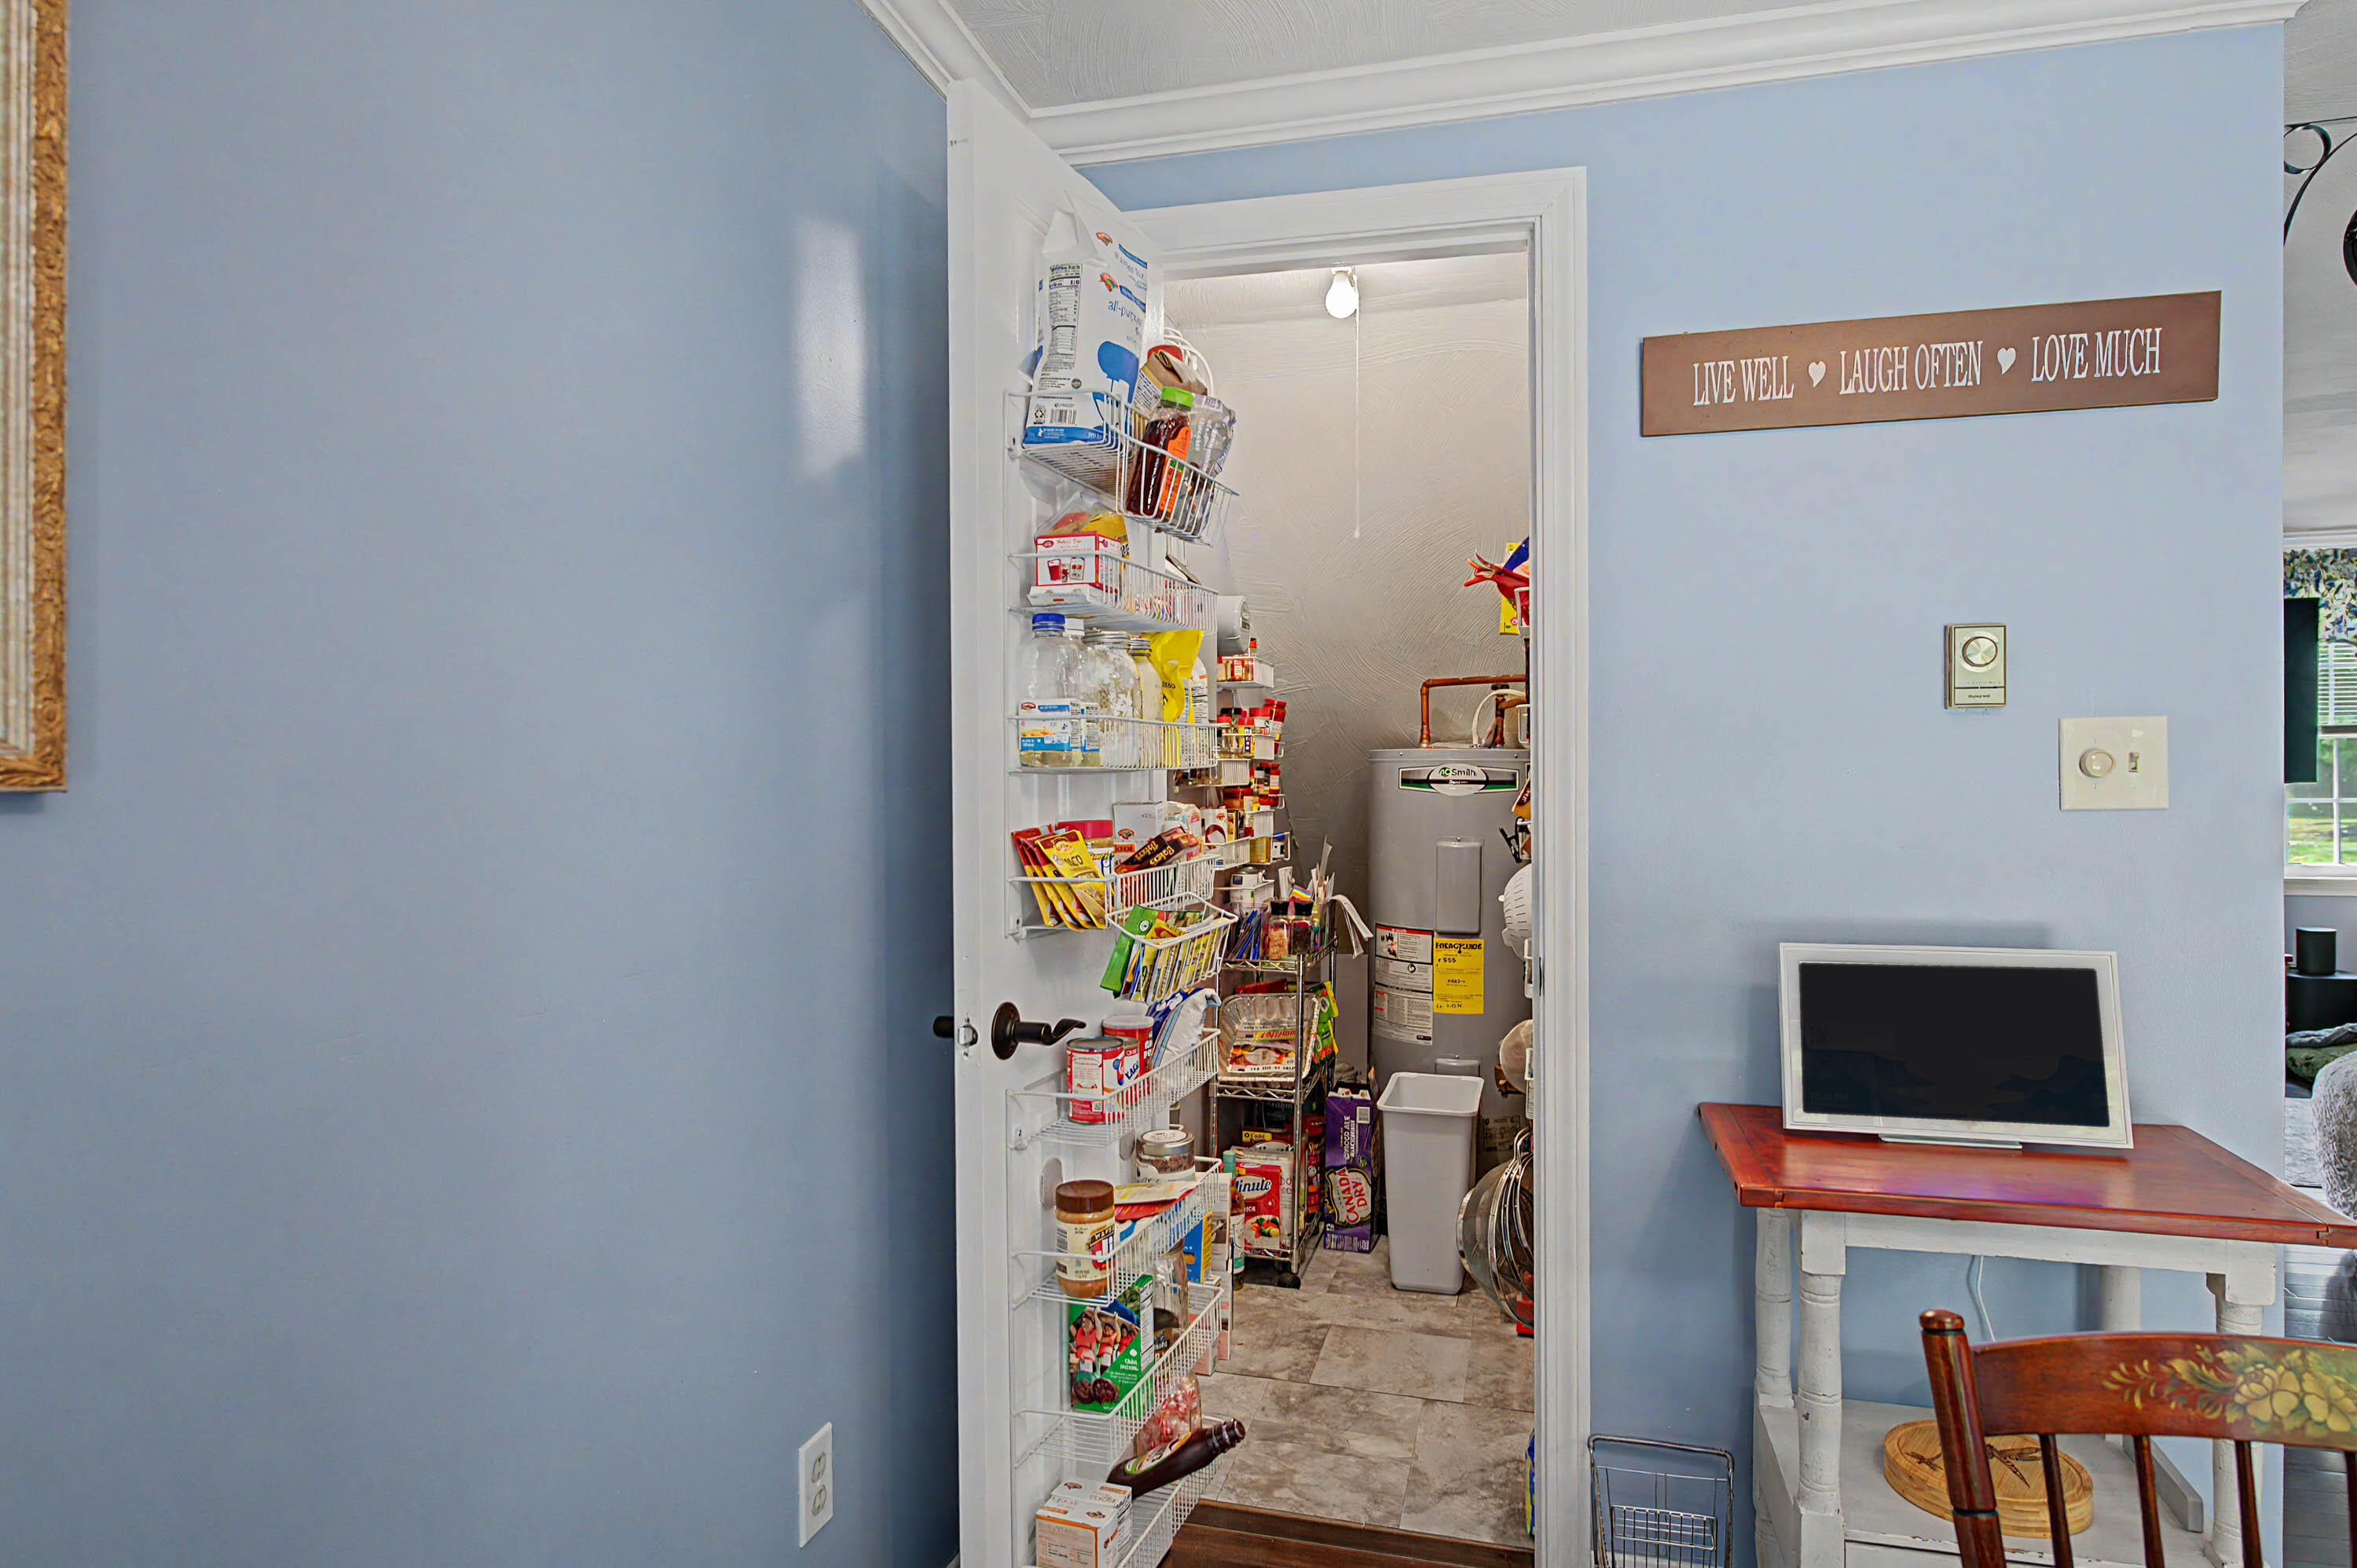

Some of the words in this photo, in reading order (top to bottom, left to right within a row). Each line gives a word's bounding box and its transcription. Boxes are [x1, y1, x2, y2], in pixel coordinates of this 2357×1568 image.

[1692, 360, 1736, 406] LIVE
[1740, 355, 1794, 401] WELL
[1839, 346, 1909, 394] LAUGH
[1914, 340, 1983, 390] OFTEN
[2031, 333, 2089, 383] LOVE
[2094, 327, 2162, 378] MUCH
[1451, 768, 1476, 777] Smith
[1336, 1167, 1360, 1224] CANADA
[1351, 1180, 1368, 1207] DRY
